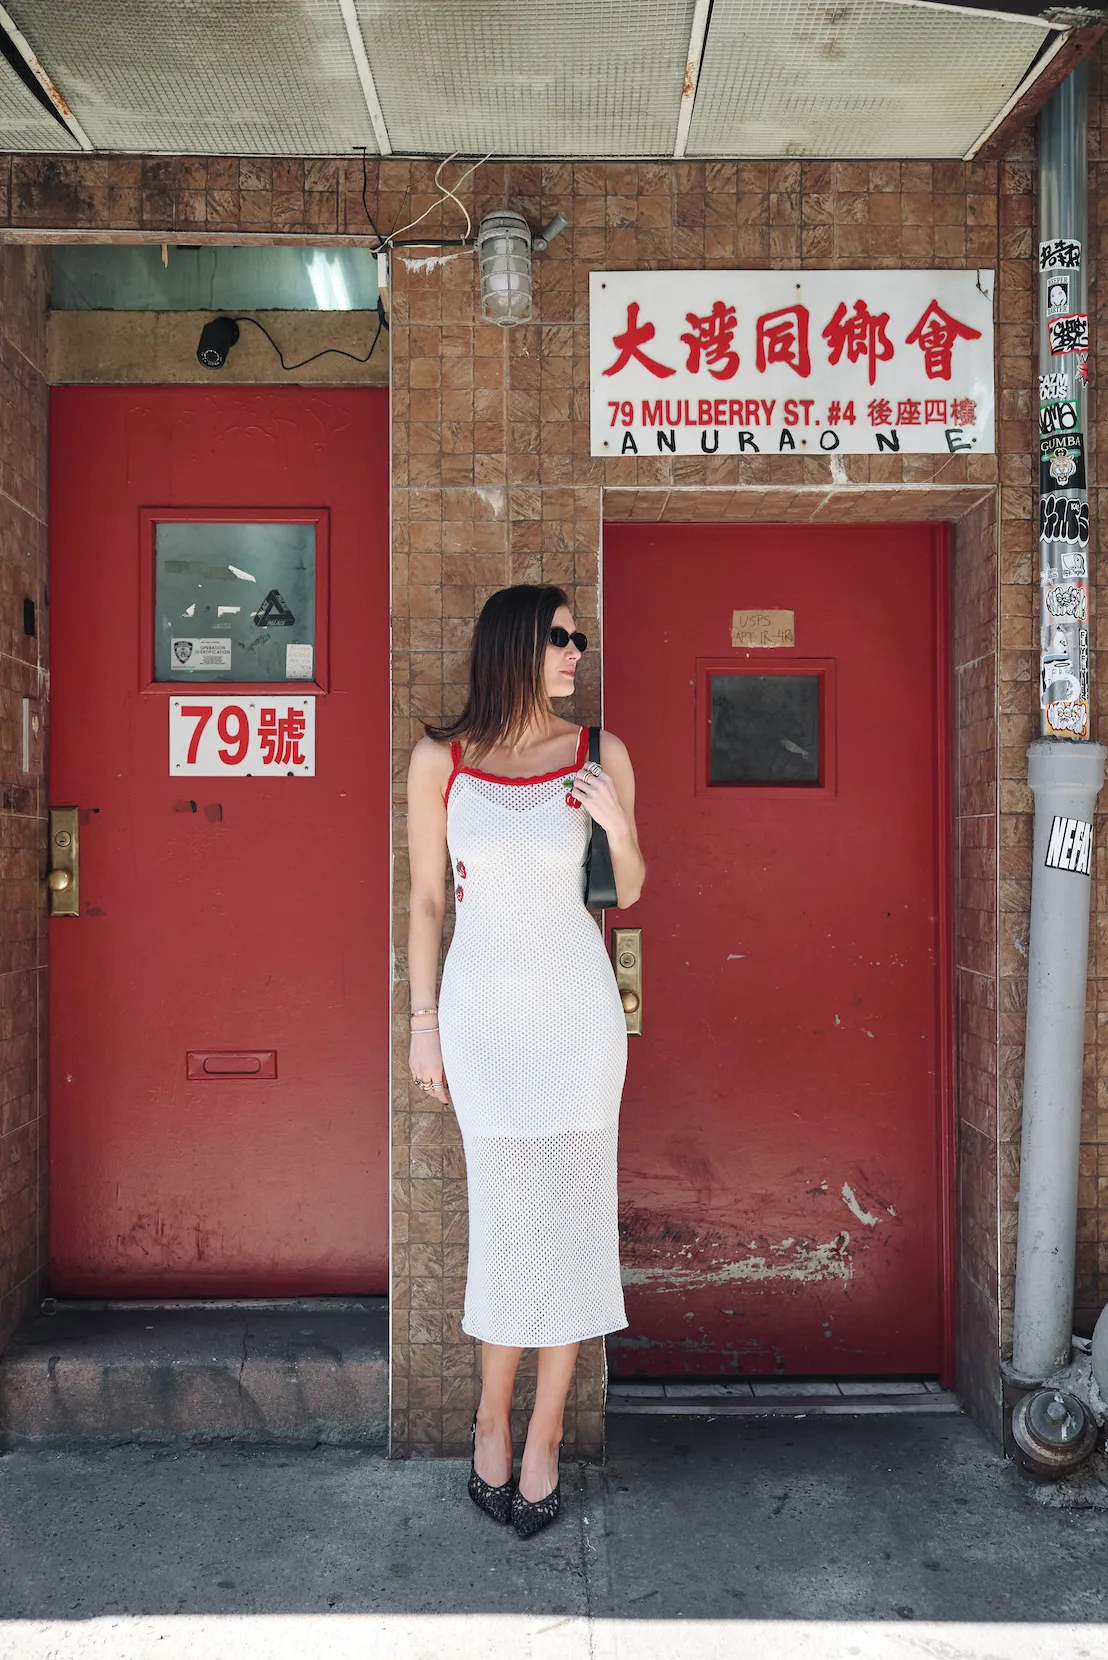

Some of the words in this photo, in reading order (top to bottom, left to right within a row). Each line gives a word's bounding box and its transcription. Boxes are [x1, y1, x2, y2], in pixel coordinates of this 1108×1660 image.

[607, 400, 634, 427] 79
[641, 399, 776, 427] MULBERRY
[783, 399, 820, 427] ST.
[828, 400, 856, 426] #4
[1041, 436, 1082, 452] GUMBA
[739, 614, 771, 628] USPS
[735, 631, 755, 644] APT
[181, 705, 306, 766] 79號
